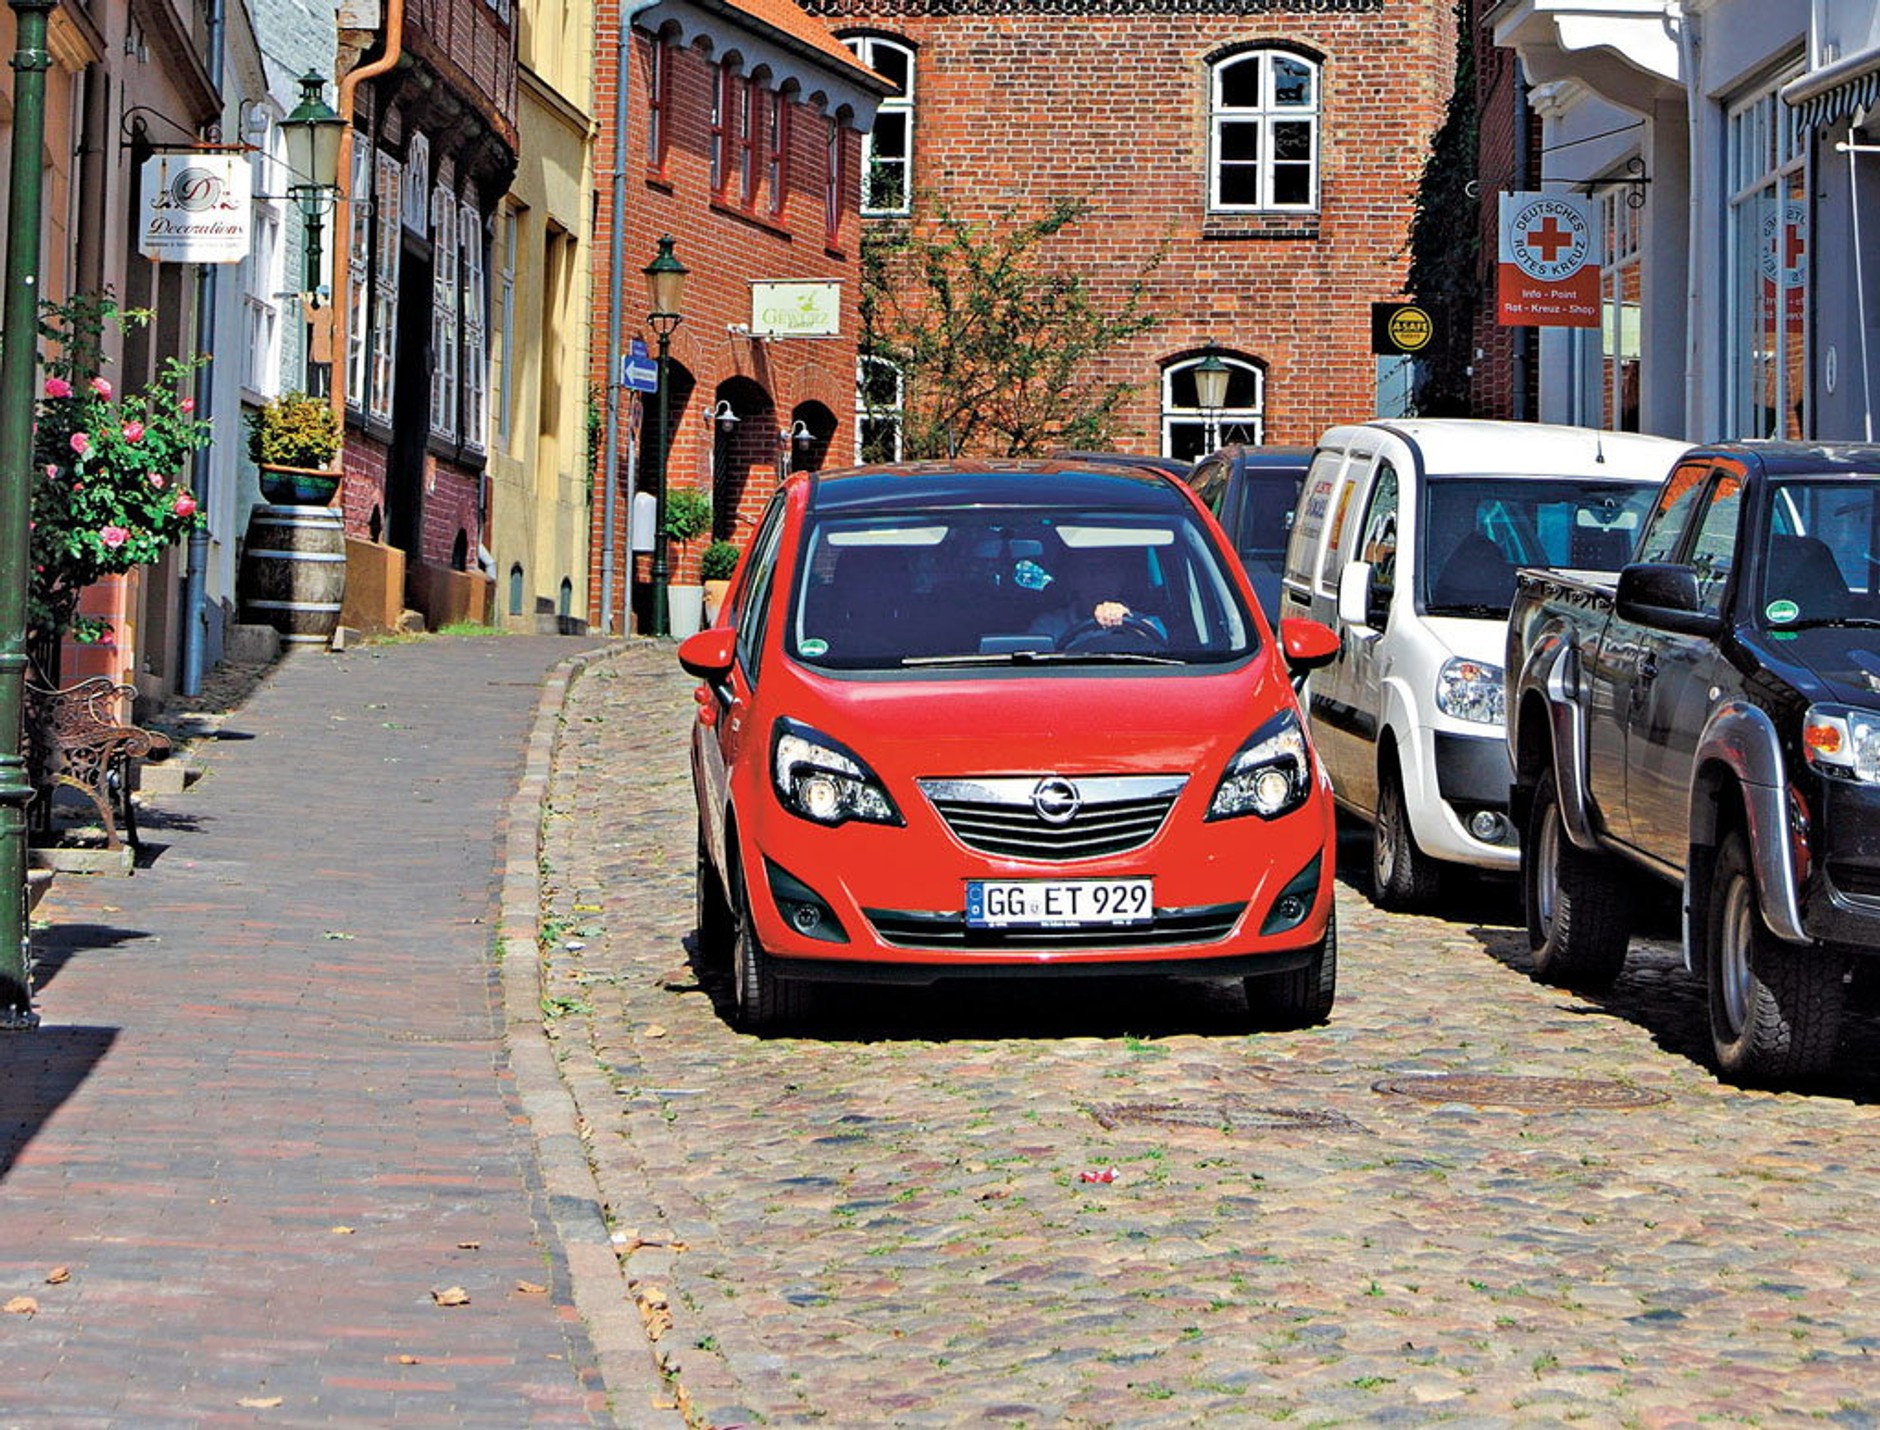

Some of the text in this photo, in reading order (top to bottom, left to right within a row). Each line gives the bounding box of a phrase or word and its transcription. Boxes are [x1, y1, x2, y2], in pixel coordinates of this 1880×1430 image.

[1516, 201, 1584, 232] DEUTSCHES
[1514, 239, 1586, 275] ROTES KREUZ
[1521, 289, 1541, 299] Info
[1551, 289, 1577, 299] Point
[1531, 304, 1560, 314] Kreuz
[1569, 305, 1595, 316] Shop
[987, 885, 1147, 916] GG ET 929
